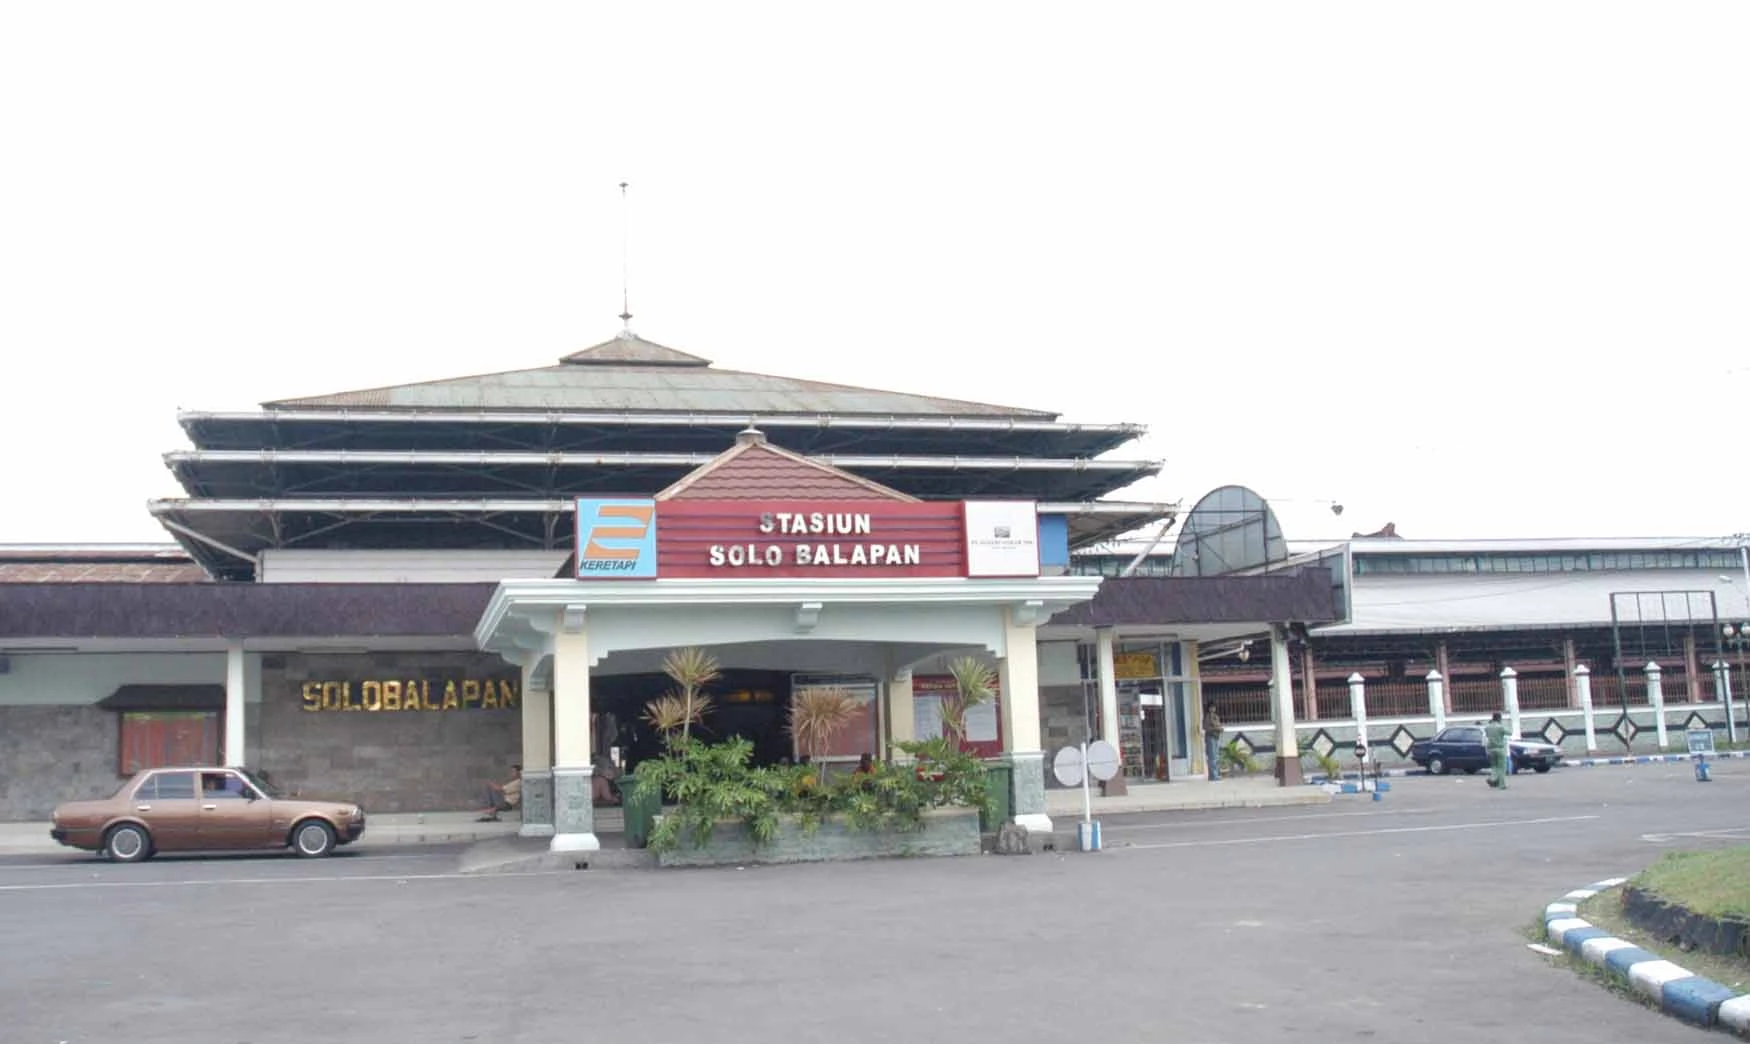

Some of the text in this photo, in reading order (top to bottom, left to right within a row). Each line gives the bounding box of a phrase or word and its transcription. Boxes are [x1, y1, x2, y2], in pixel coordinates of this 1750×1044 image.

[759, 512, 871, 534] STASIUN
[580, 560, 636, 571] KERETAPI
[709, 544, 920, 567] SOLO BALAPAN
